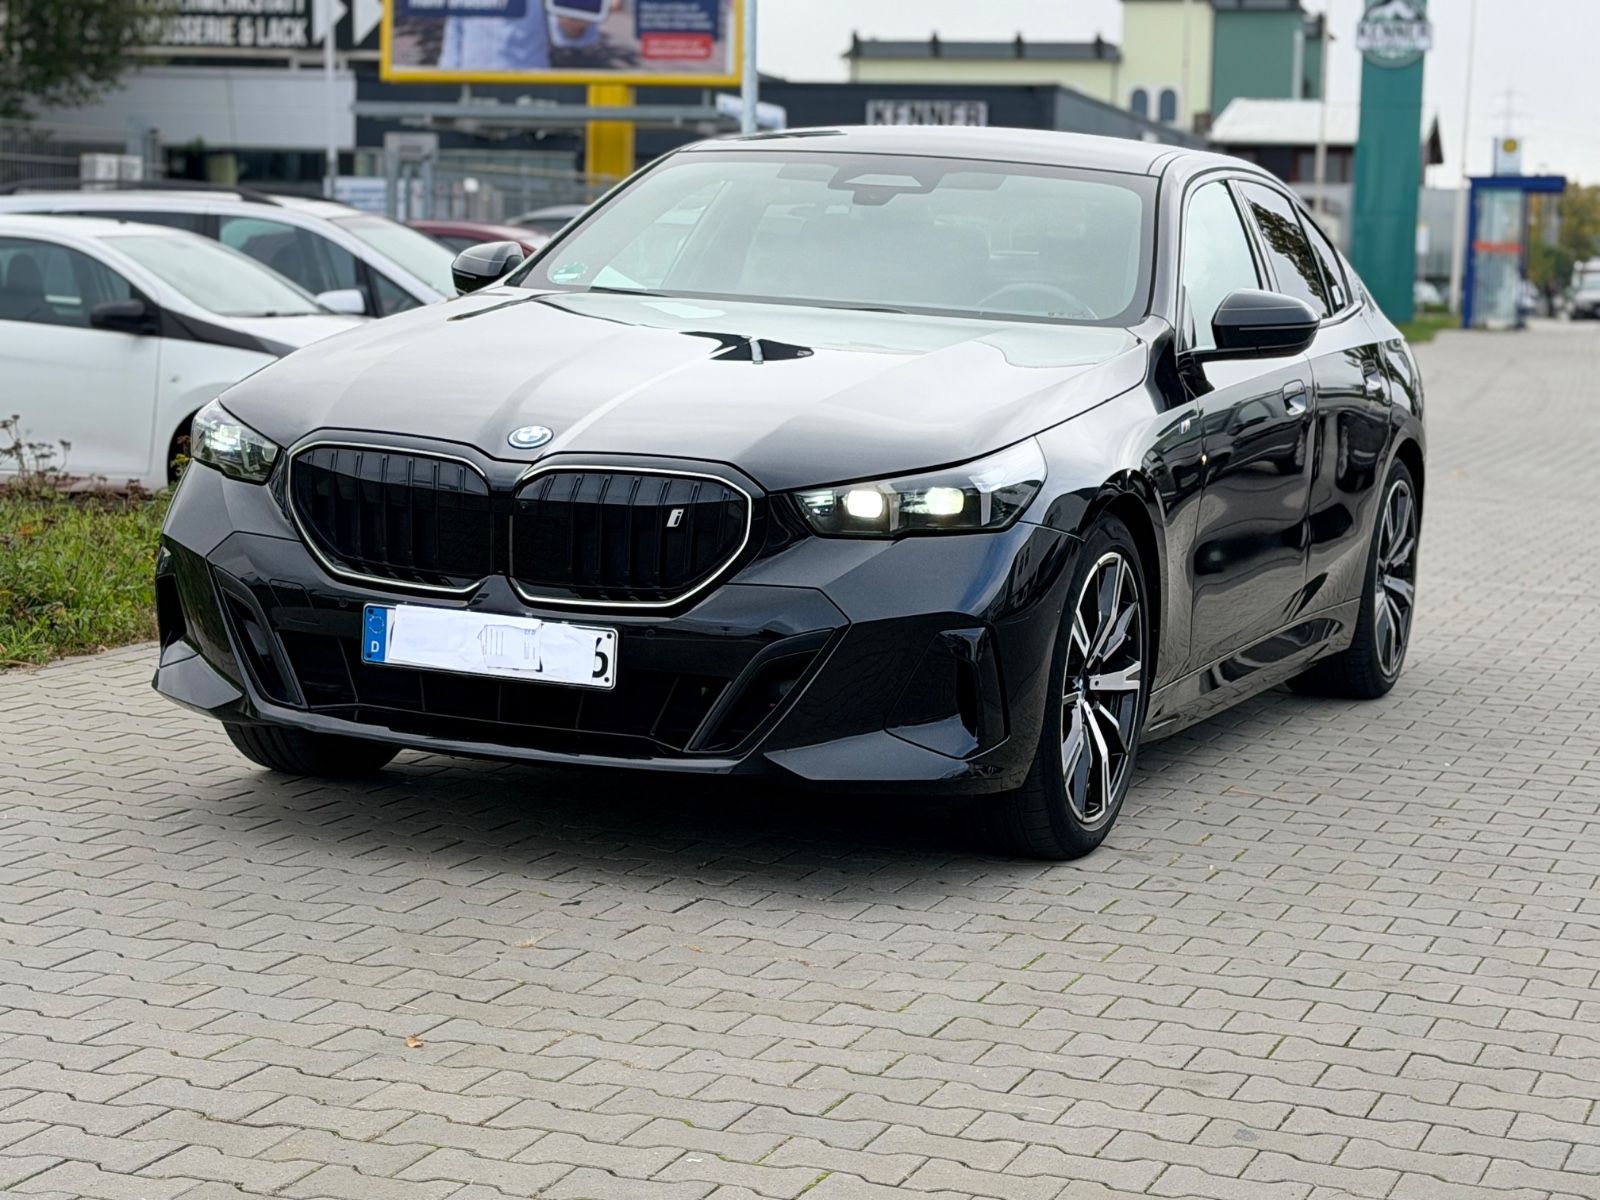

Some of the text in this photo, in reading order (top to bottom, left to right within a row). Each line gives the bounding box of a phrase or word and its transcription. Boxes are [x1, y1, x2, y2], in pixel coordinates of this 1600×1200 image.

[256, 17, 308, 47] LACK
[866, 99, 988, 126] KENNER
[371, 640, 380, 653] D
